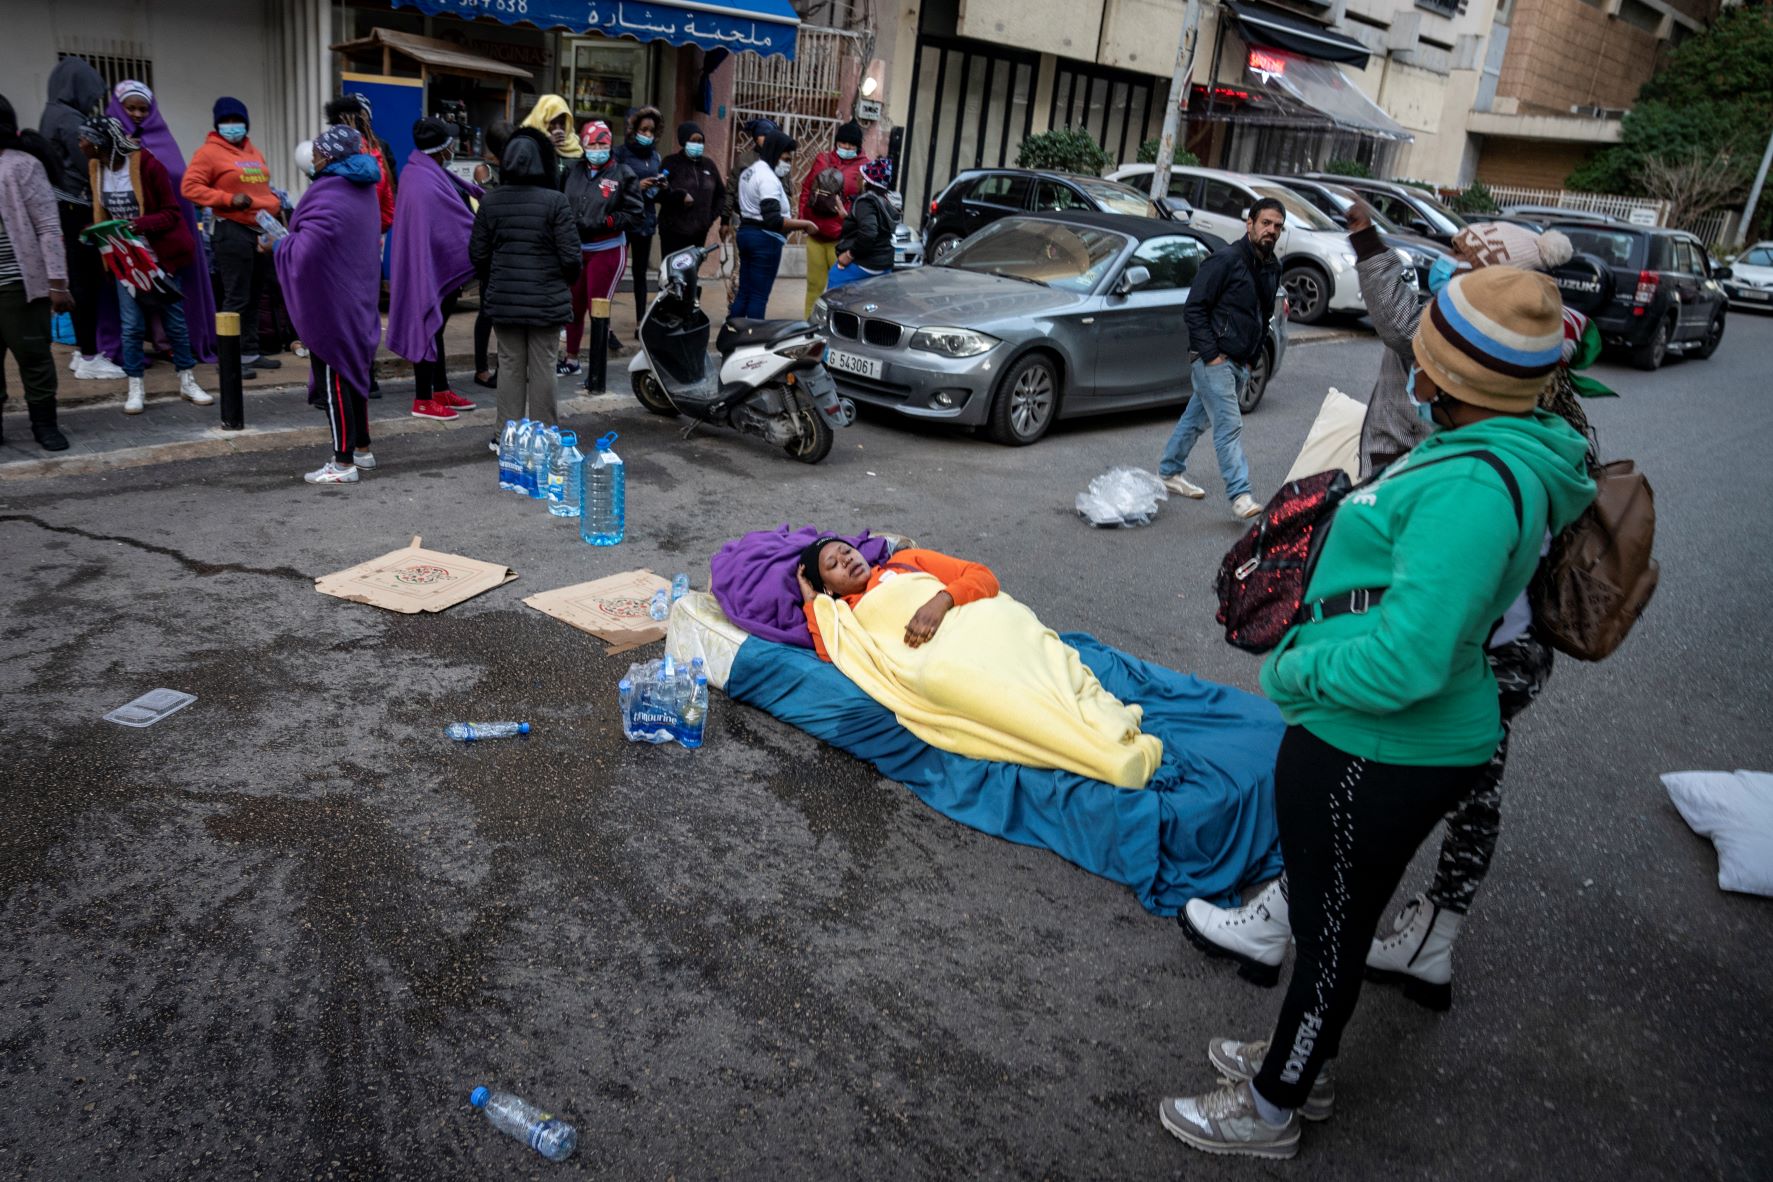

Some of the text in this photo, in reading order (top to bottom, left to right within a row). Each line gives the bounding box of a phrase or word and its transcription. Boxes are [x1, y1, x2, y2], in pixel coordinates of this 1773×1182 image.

[587, 1, 676, 38] بشارة
[829, 351, 874, 376] G 543061
